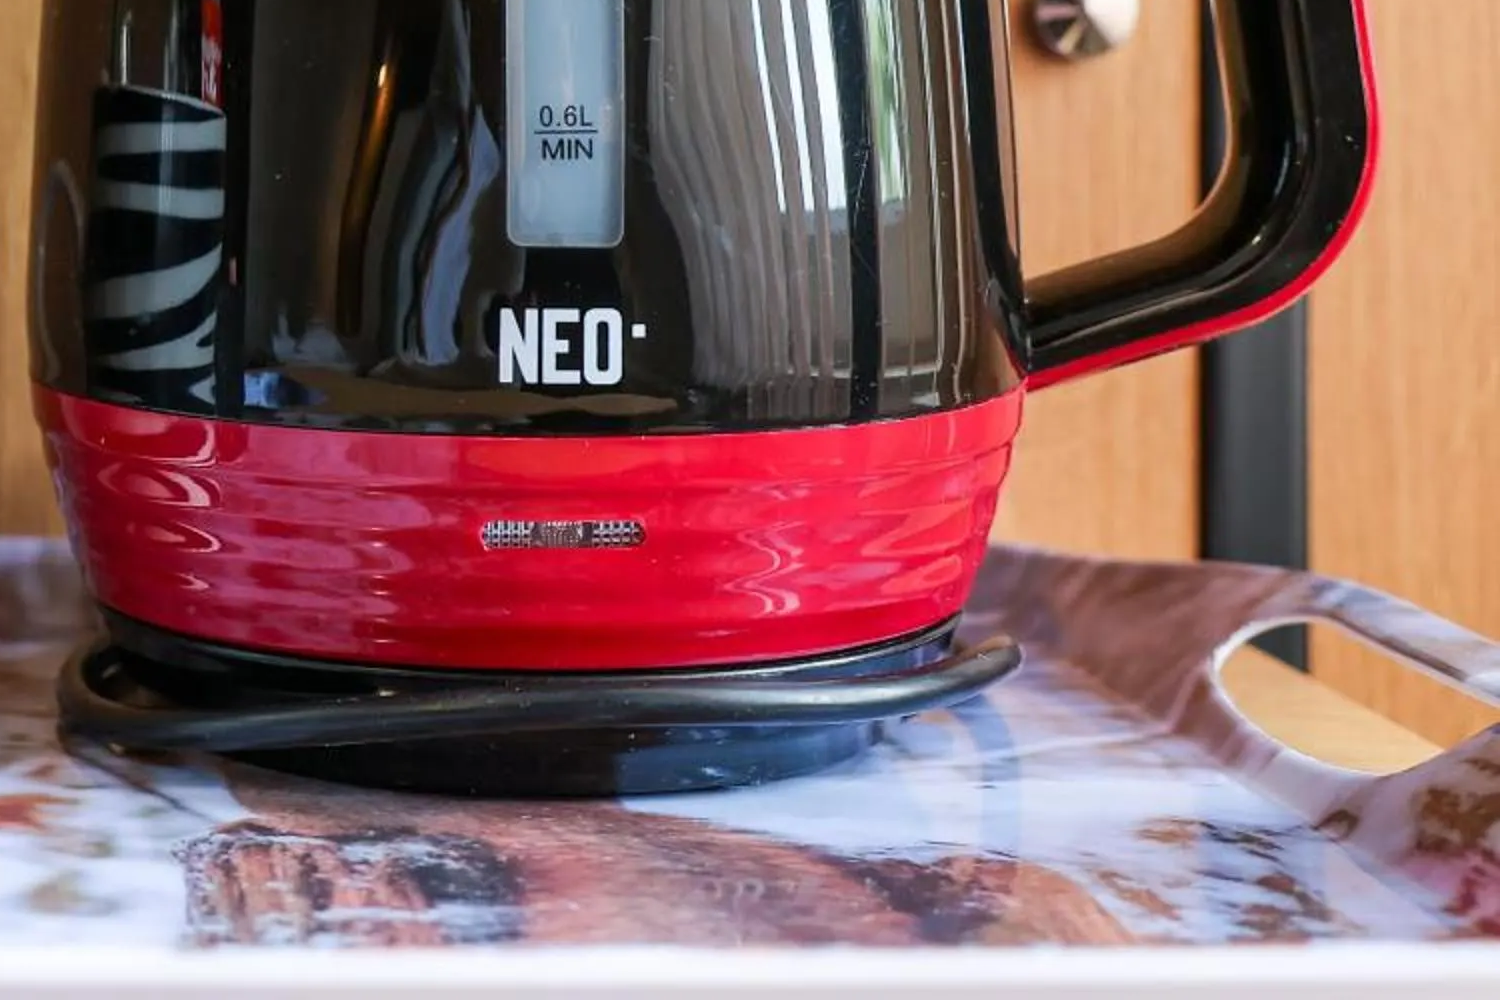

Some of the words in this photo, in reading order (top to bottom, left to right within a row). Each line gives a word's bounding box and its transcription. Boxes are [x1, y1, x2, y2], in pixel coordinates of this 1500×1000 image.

[539, 104, 593, 128] 0.6L
[541, 138, 594, 161] MIN
[499, 307, 623, 386] NEO
